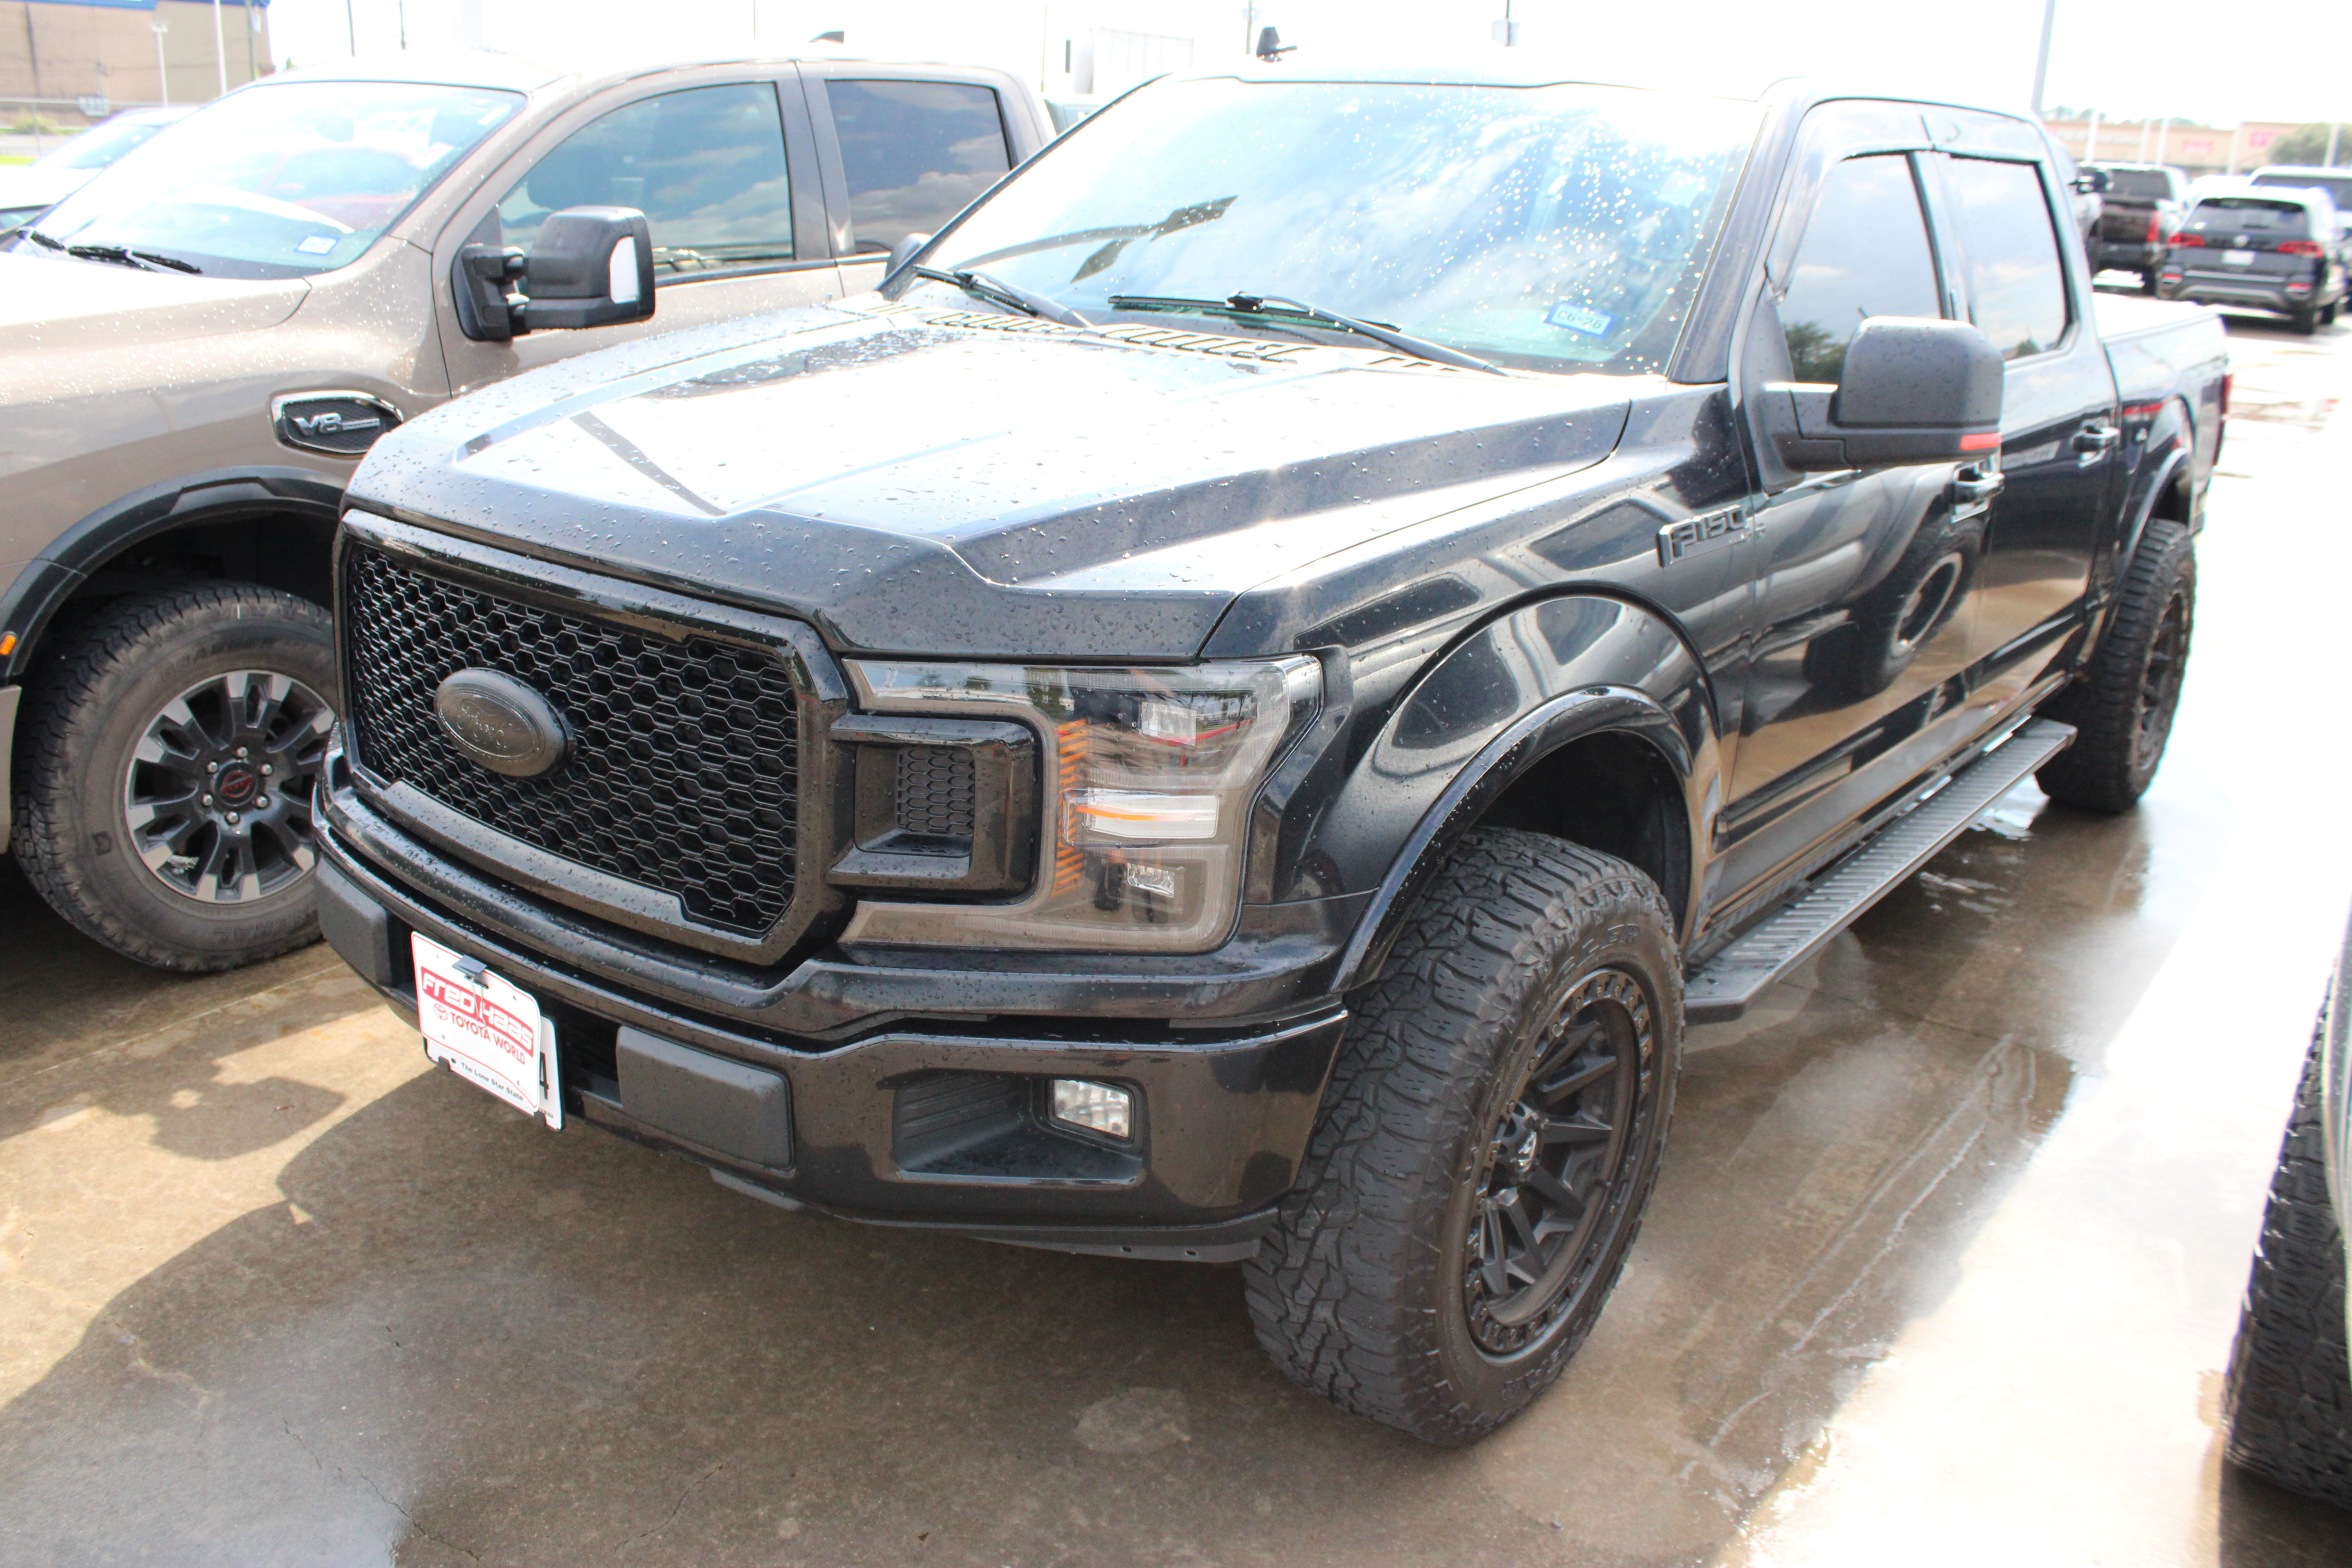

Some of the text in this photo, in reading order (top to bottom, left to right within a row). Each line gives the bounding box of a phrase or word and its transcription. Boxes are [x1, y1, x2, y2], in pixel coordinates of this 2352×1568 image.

[290, 412, 342, 437] V8
[450, 1012, 526, 1065] TOYOTA WORLD
[461, 1062, 523, 1101] The Lone Star State
